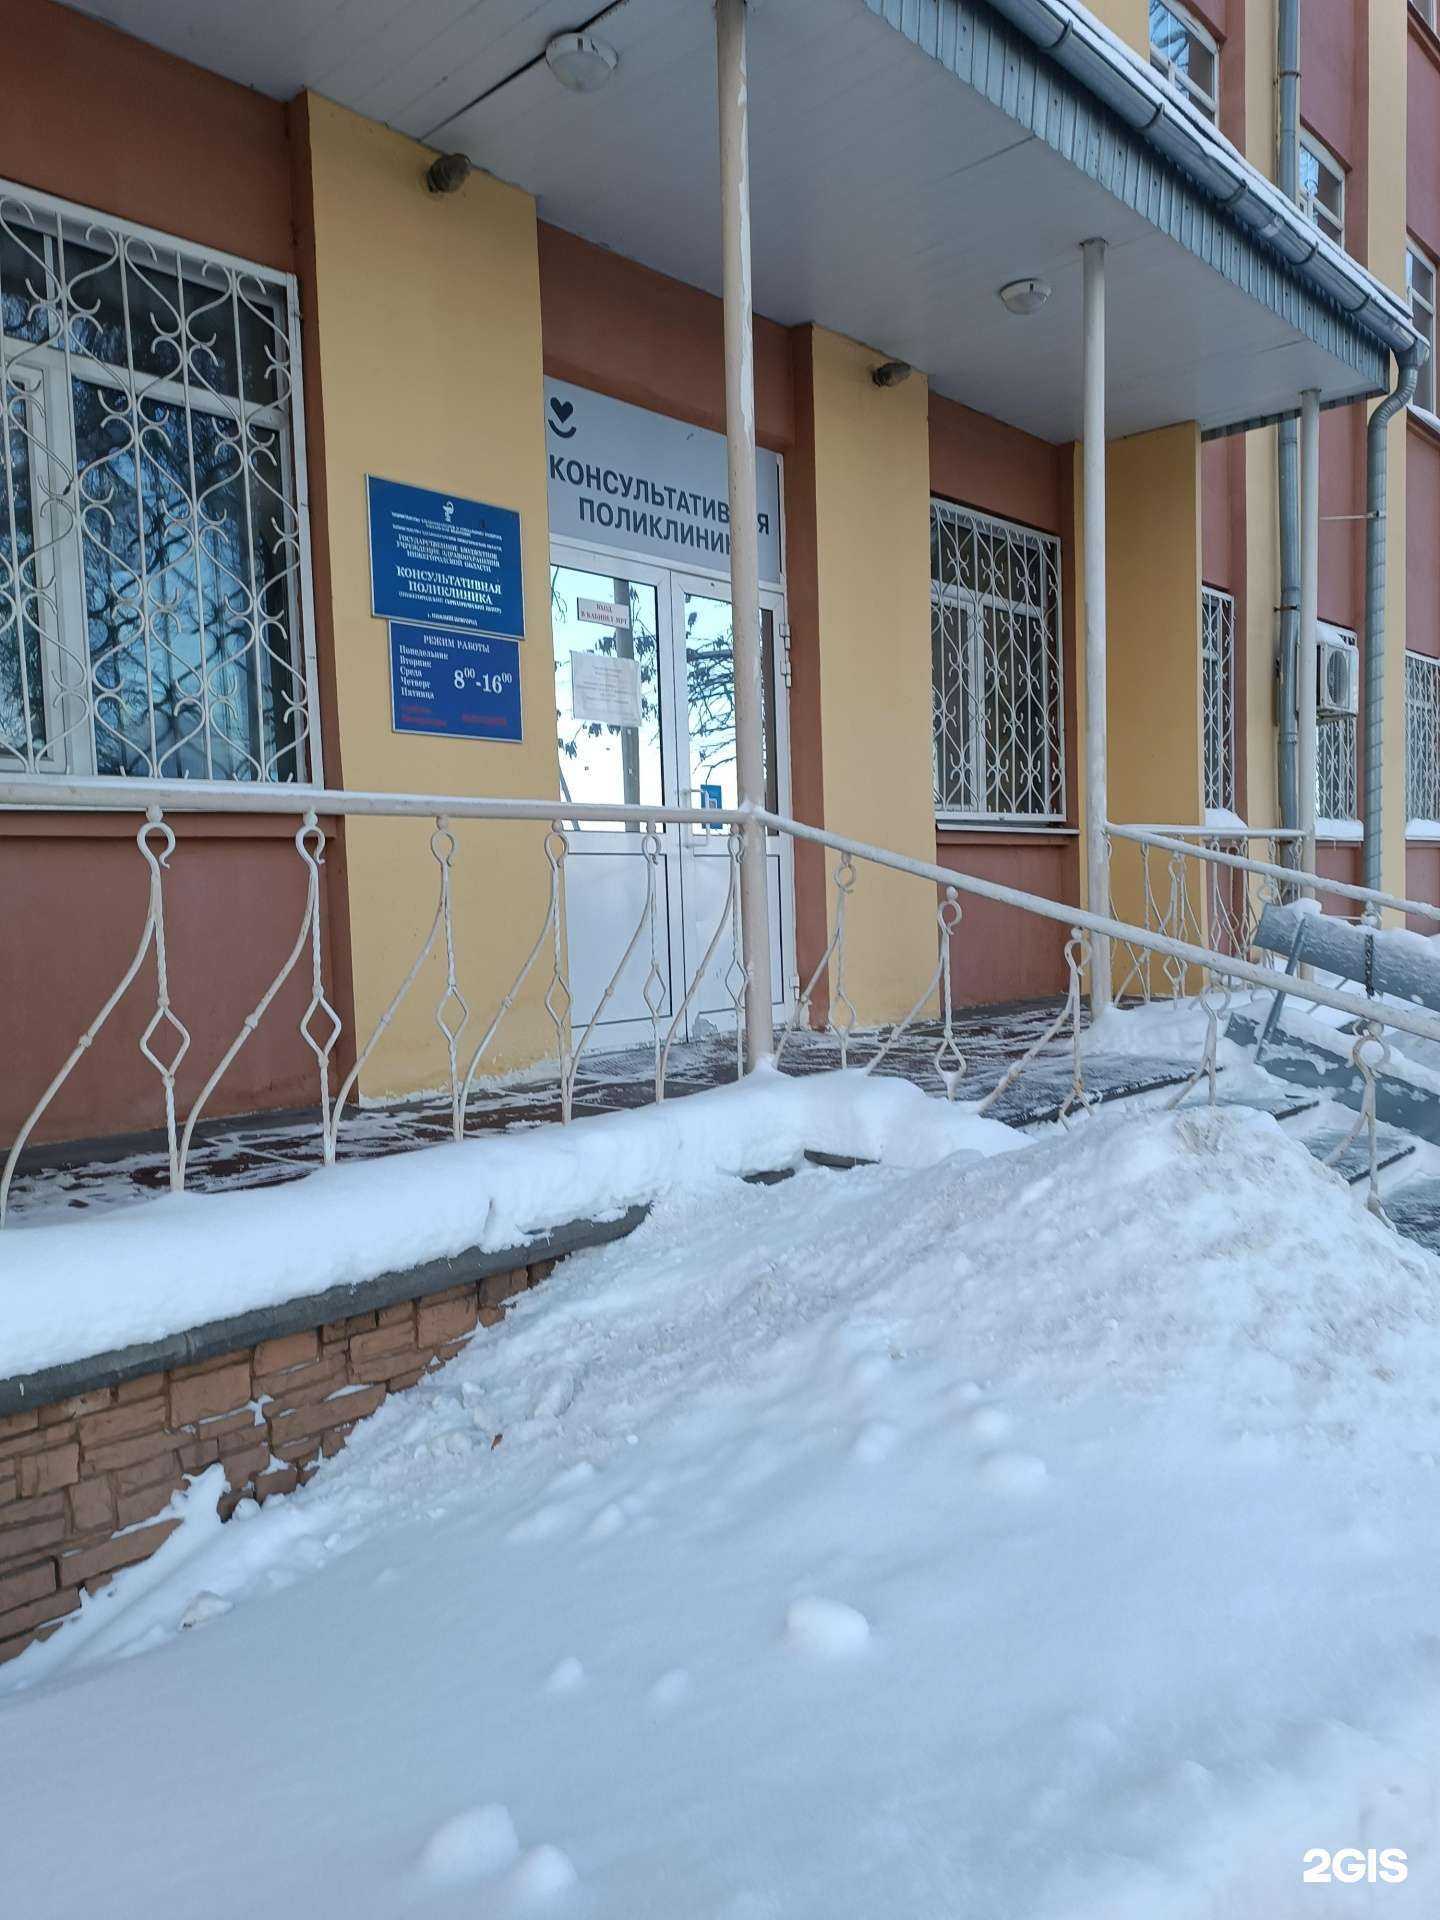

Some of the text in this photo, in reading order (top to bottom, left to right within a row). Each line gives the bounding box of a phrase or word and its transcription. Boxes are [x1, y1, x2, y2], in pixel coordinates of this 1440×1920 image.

[549, 454, 770, 535] КОНСУЛЬТАТИВЯ
[578, 496, 732, 555] ПОЛИКЛИНИ
[395, 565, 502, 595] КОНСУЛЬТАТИВНАЯ
[408, 580, 494, 606] ПОЛИКЛИНИКА
[399, 644, 449, 661] Понедельник
[423, 634, 490, 654] РЕЖИМ РАБОТЫ
[399, 654, 432, 669] Вторник
[399, 665, 423, 678] Среда
[400, 675, 431, 690] Четверг
[400, 686, 435, 701] Пятница
